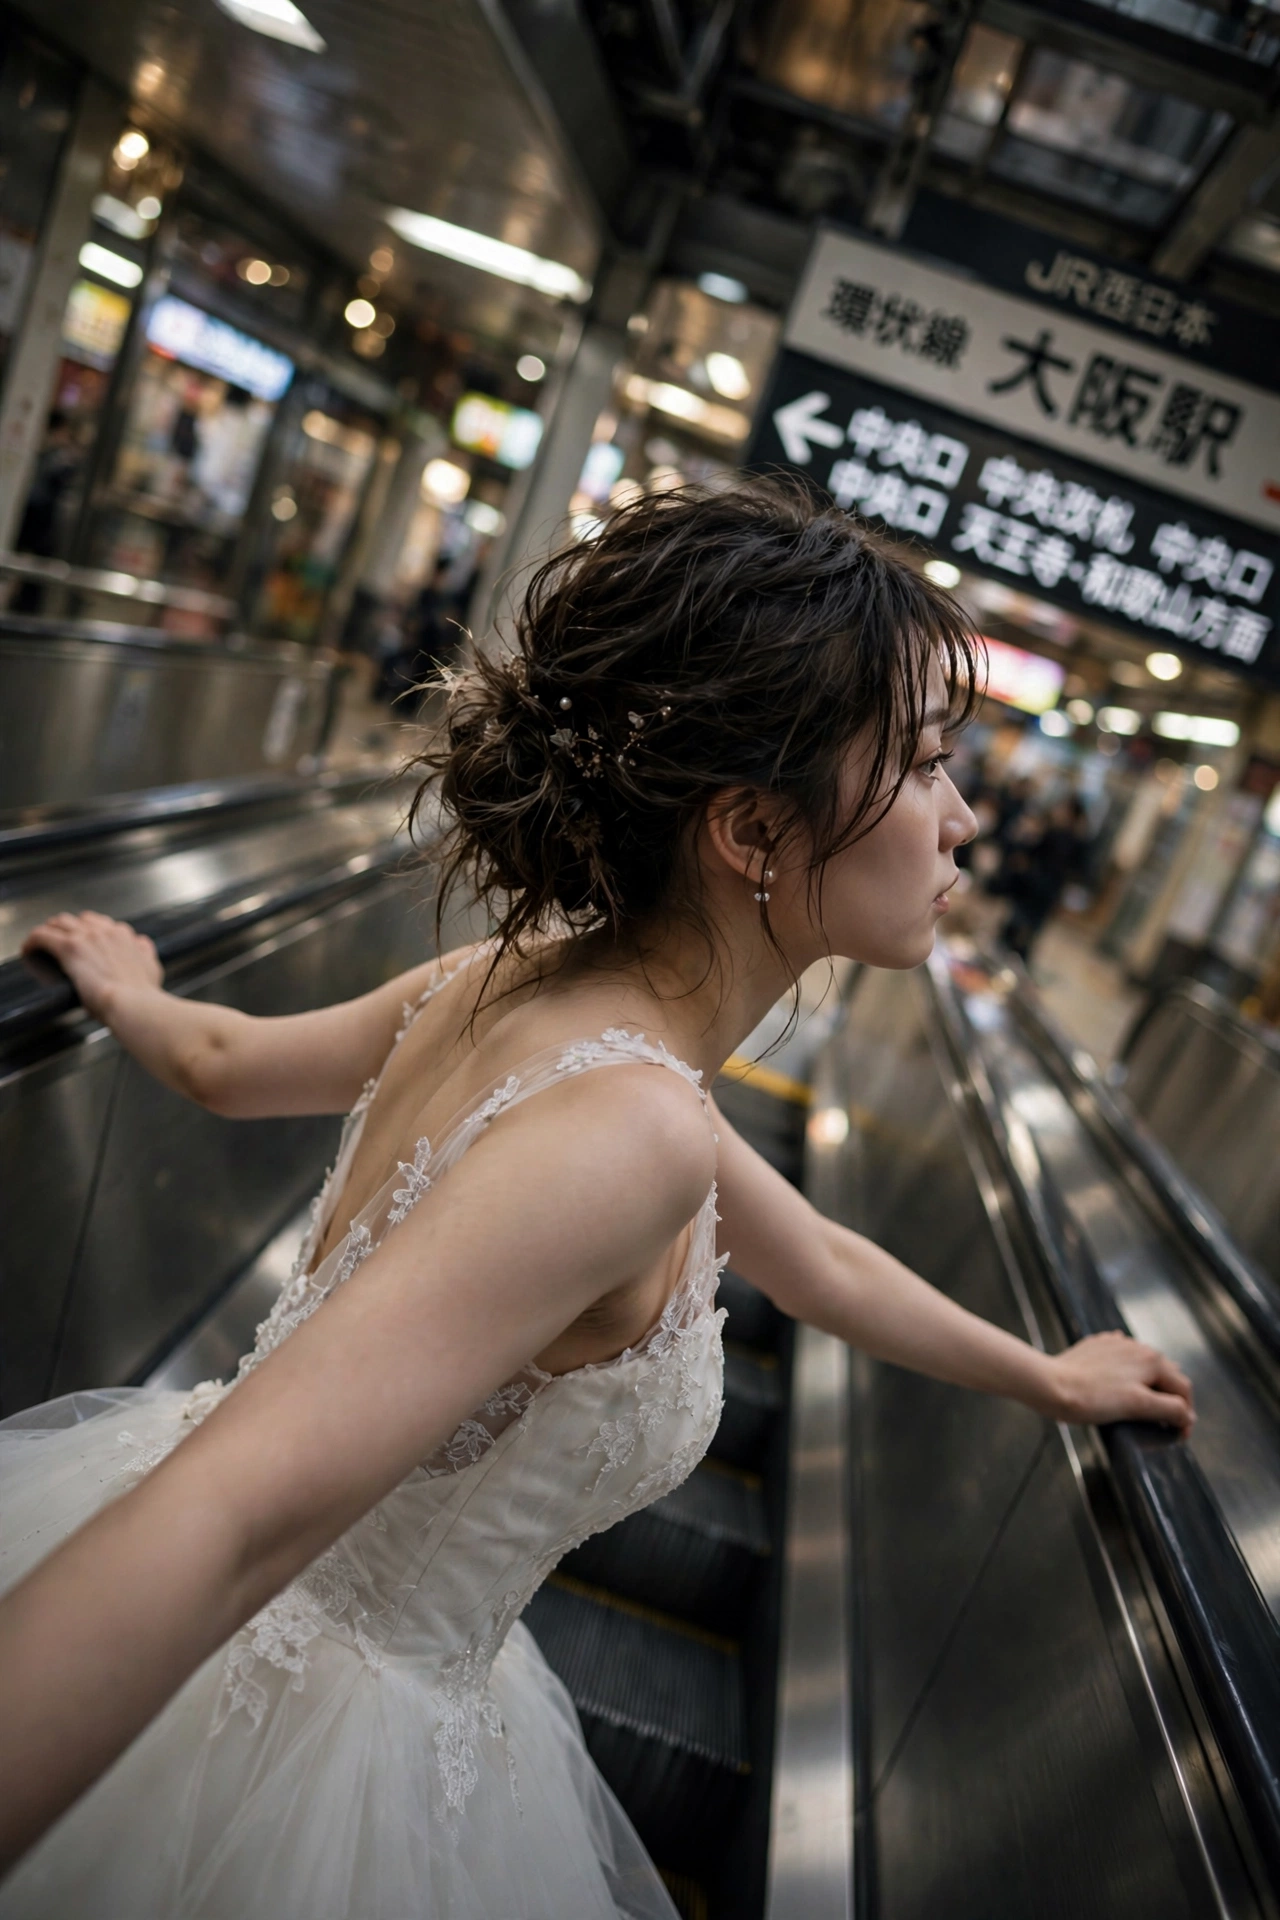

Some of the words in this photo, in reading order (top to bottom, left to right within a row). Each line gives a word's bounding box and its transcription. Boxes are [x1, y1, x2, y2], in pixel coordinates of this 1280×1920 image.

[1025, 251, 1219, 346] JR西日本
[988, 329, 1244, 479] 大阪駅
[827, 458, 950, 539] 中央口
[846, 406, 970, 489] 中央口
[977, 455, 1136, 554] 中央改札
[1150, 521, 1274, 604] 中央口
